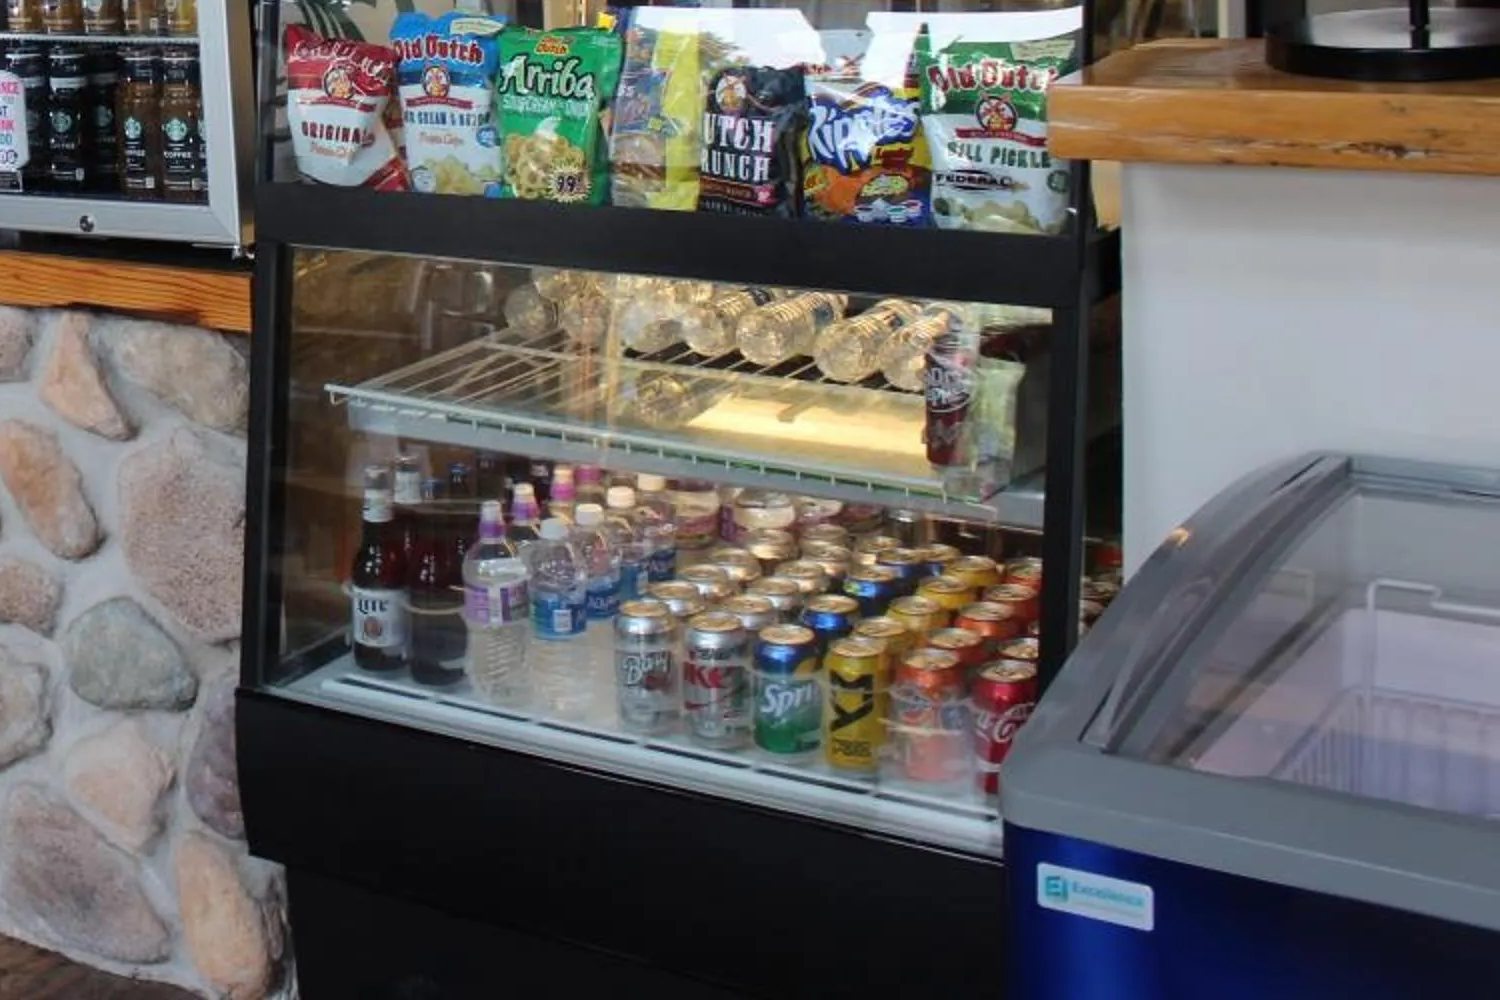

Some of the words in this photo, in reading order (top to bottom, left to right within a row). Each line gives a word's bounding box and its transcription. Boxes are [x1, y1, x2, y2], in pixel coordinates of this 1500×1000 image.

[424, 33, 485, 66] Dutch
[500, 53, 596, 99] Arriba
[927, 62, 977, 93] Old
[703, 112, 776, 153] UTCH
[163, 149, 193, 161] COFFEE
[989, 144, 1052, 169] PICKLE
[934, 171, 1015, 188] FEDERAL
[760, 681, 815, 717] Spri
